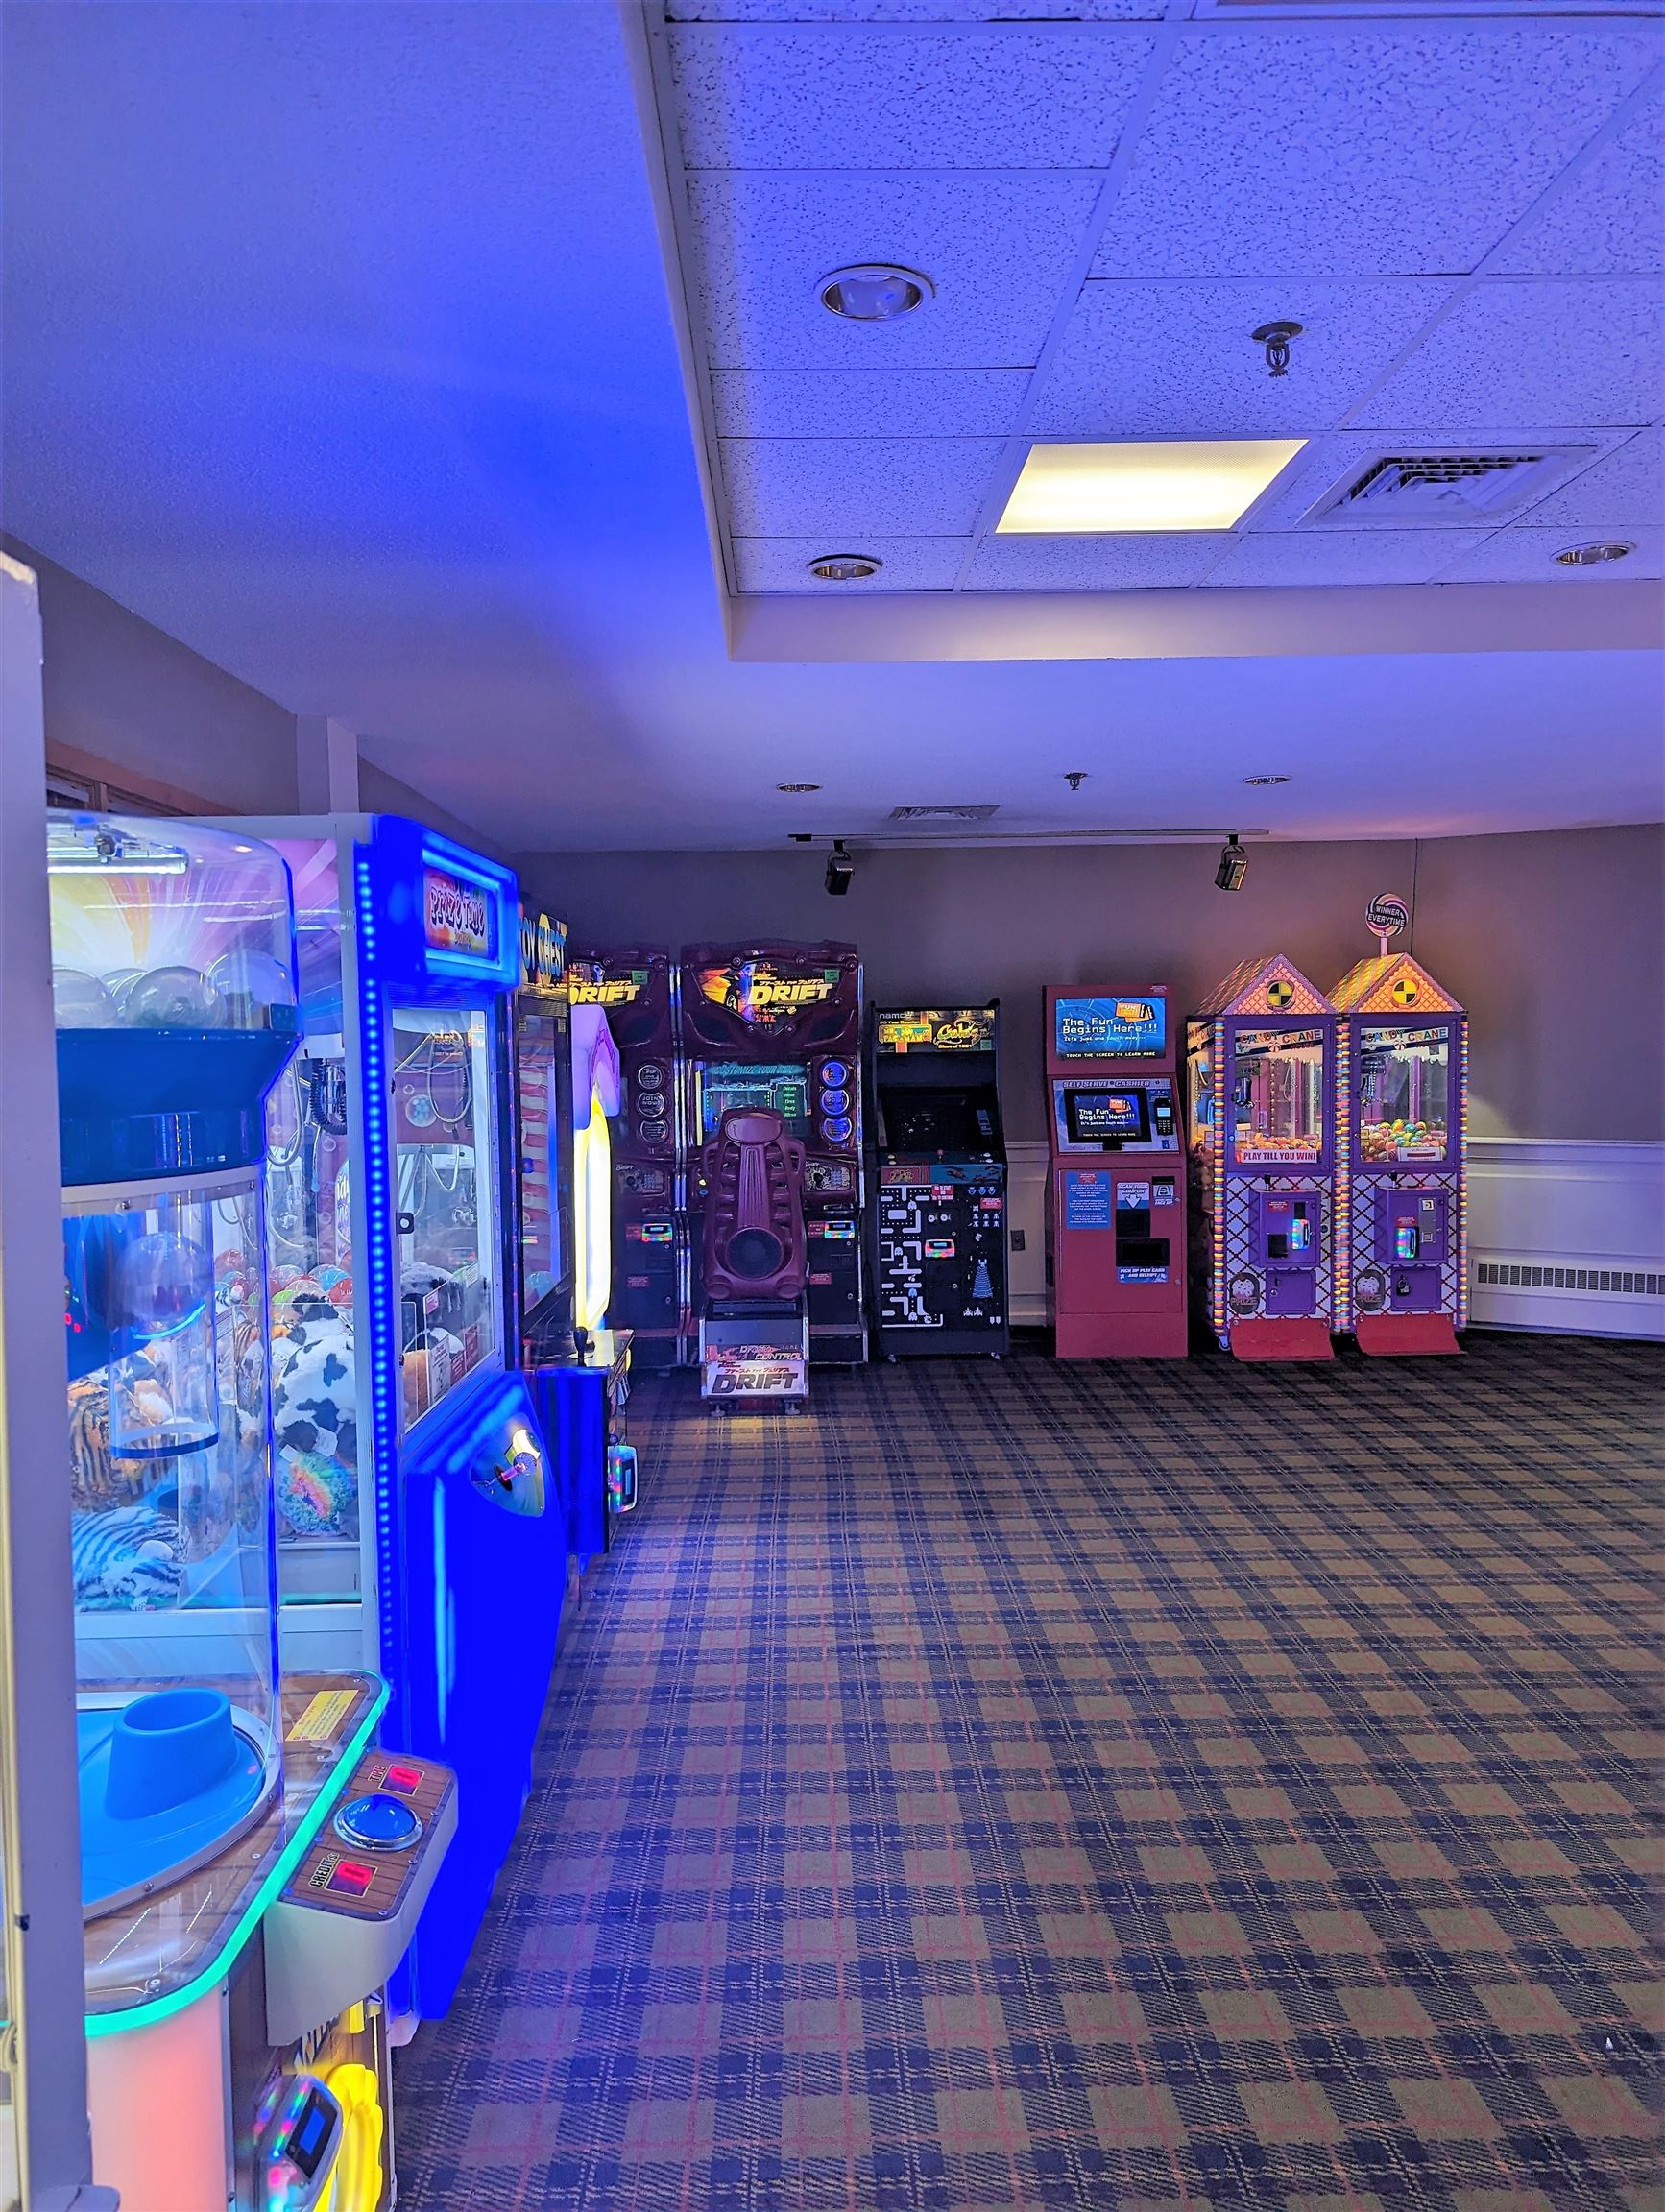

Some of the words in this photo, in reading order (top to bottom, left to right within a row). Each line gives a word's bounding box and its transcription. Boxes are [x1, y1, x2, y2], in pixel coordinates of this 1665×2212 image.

[1376, 905, 1401, 917] WINNER
[1368, 913, 1406, 926] EVERYTIME
[538, 924, 567, 977] CHEST
[747, 983, 833, 1005] DRIFT
[1063, 1018, 1085, 1026] The
[1063, 1025, 1106, 1035] Begins
[1113, 1023, 1158, 1033] Here!!!
[1240, 1031, 1280, 1044] CANDY
[1282, 1029, 1322, 1044] CRANE
[1365, 1029, 1405, 1043] CANDY
[1408, 1028, 1447, 1042] CRANE
[1243, 1152, 1262, 1161] PLAY
[1263, 1152, 1279, 1161] TILL
[1280, 1152, 1295, 1161] YOU
[1296, 1151, 1315, 1161] WIN!
[755, 1352, 803, 1360] CONTROL
[711, 1372, 799, 1394] DRIFT
[369, 1764, 387, 1782] TIME
